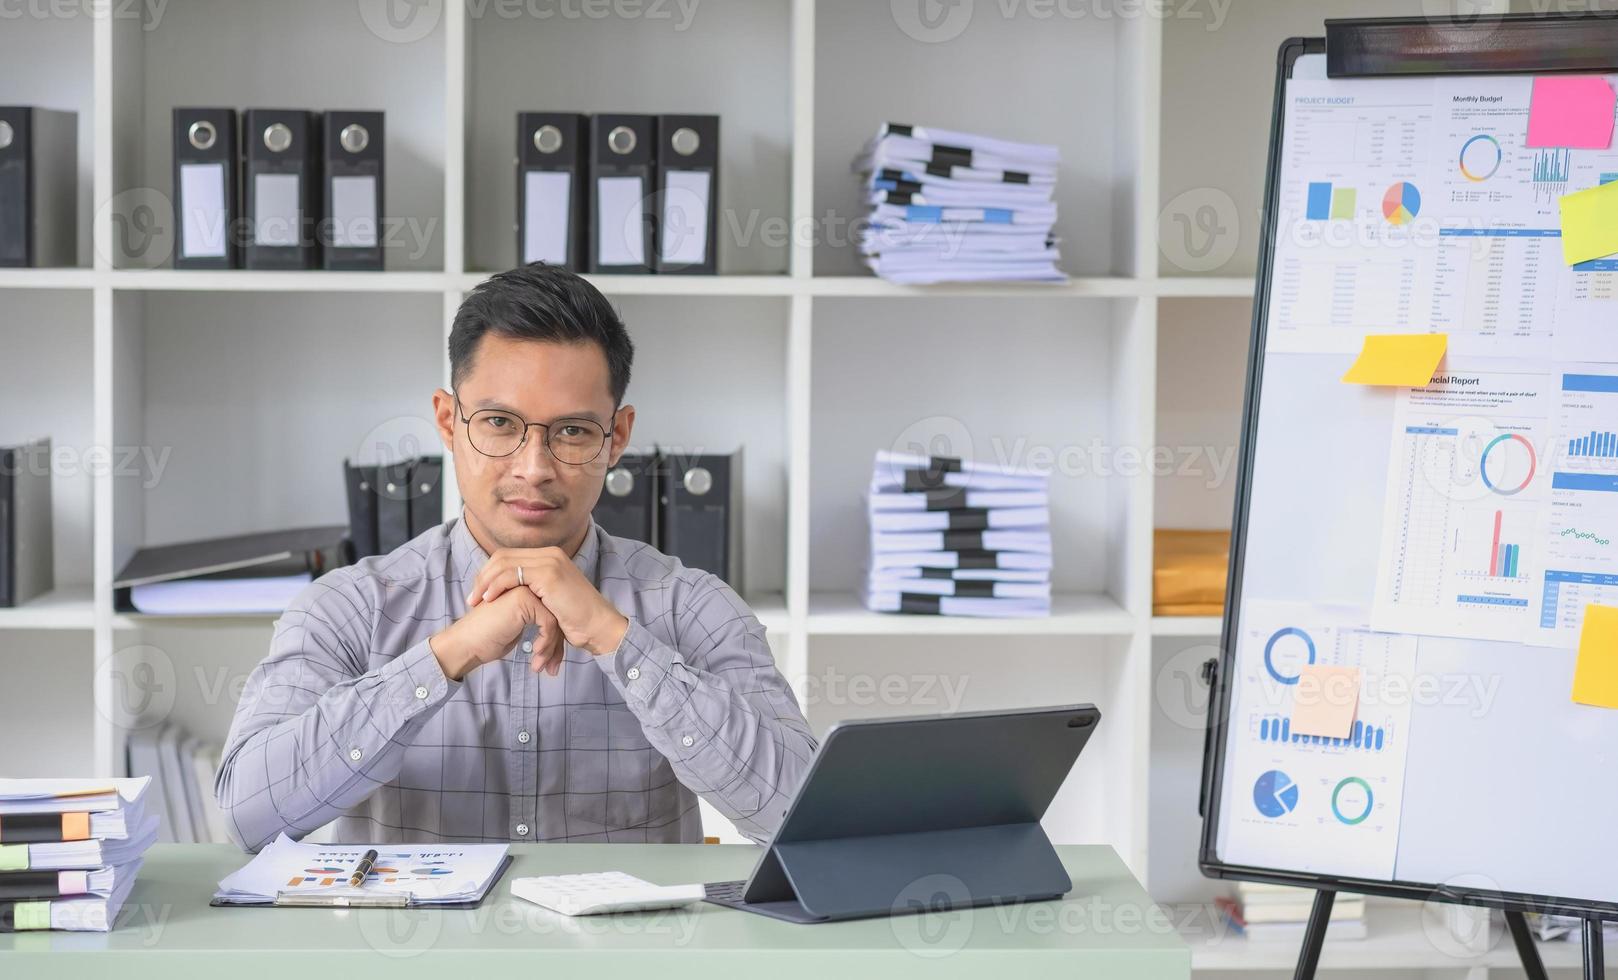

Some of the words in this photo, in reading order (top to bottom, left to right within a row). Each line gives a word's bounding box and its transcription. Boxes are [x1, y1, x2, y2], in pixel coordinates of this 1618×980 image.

[1453, 95, 1478, 103] Monthly
[1480, 95, 1503, 103] Budget
[1451, 376, 1480, 386] Report
